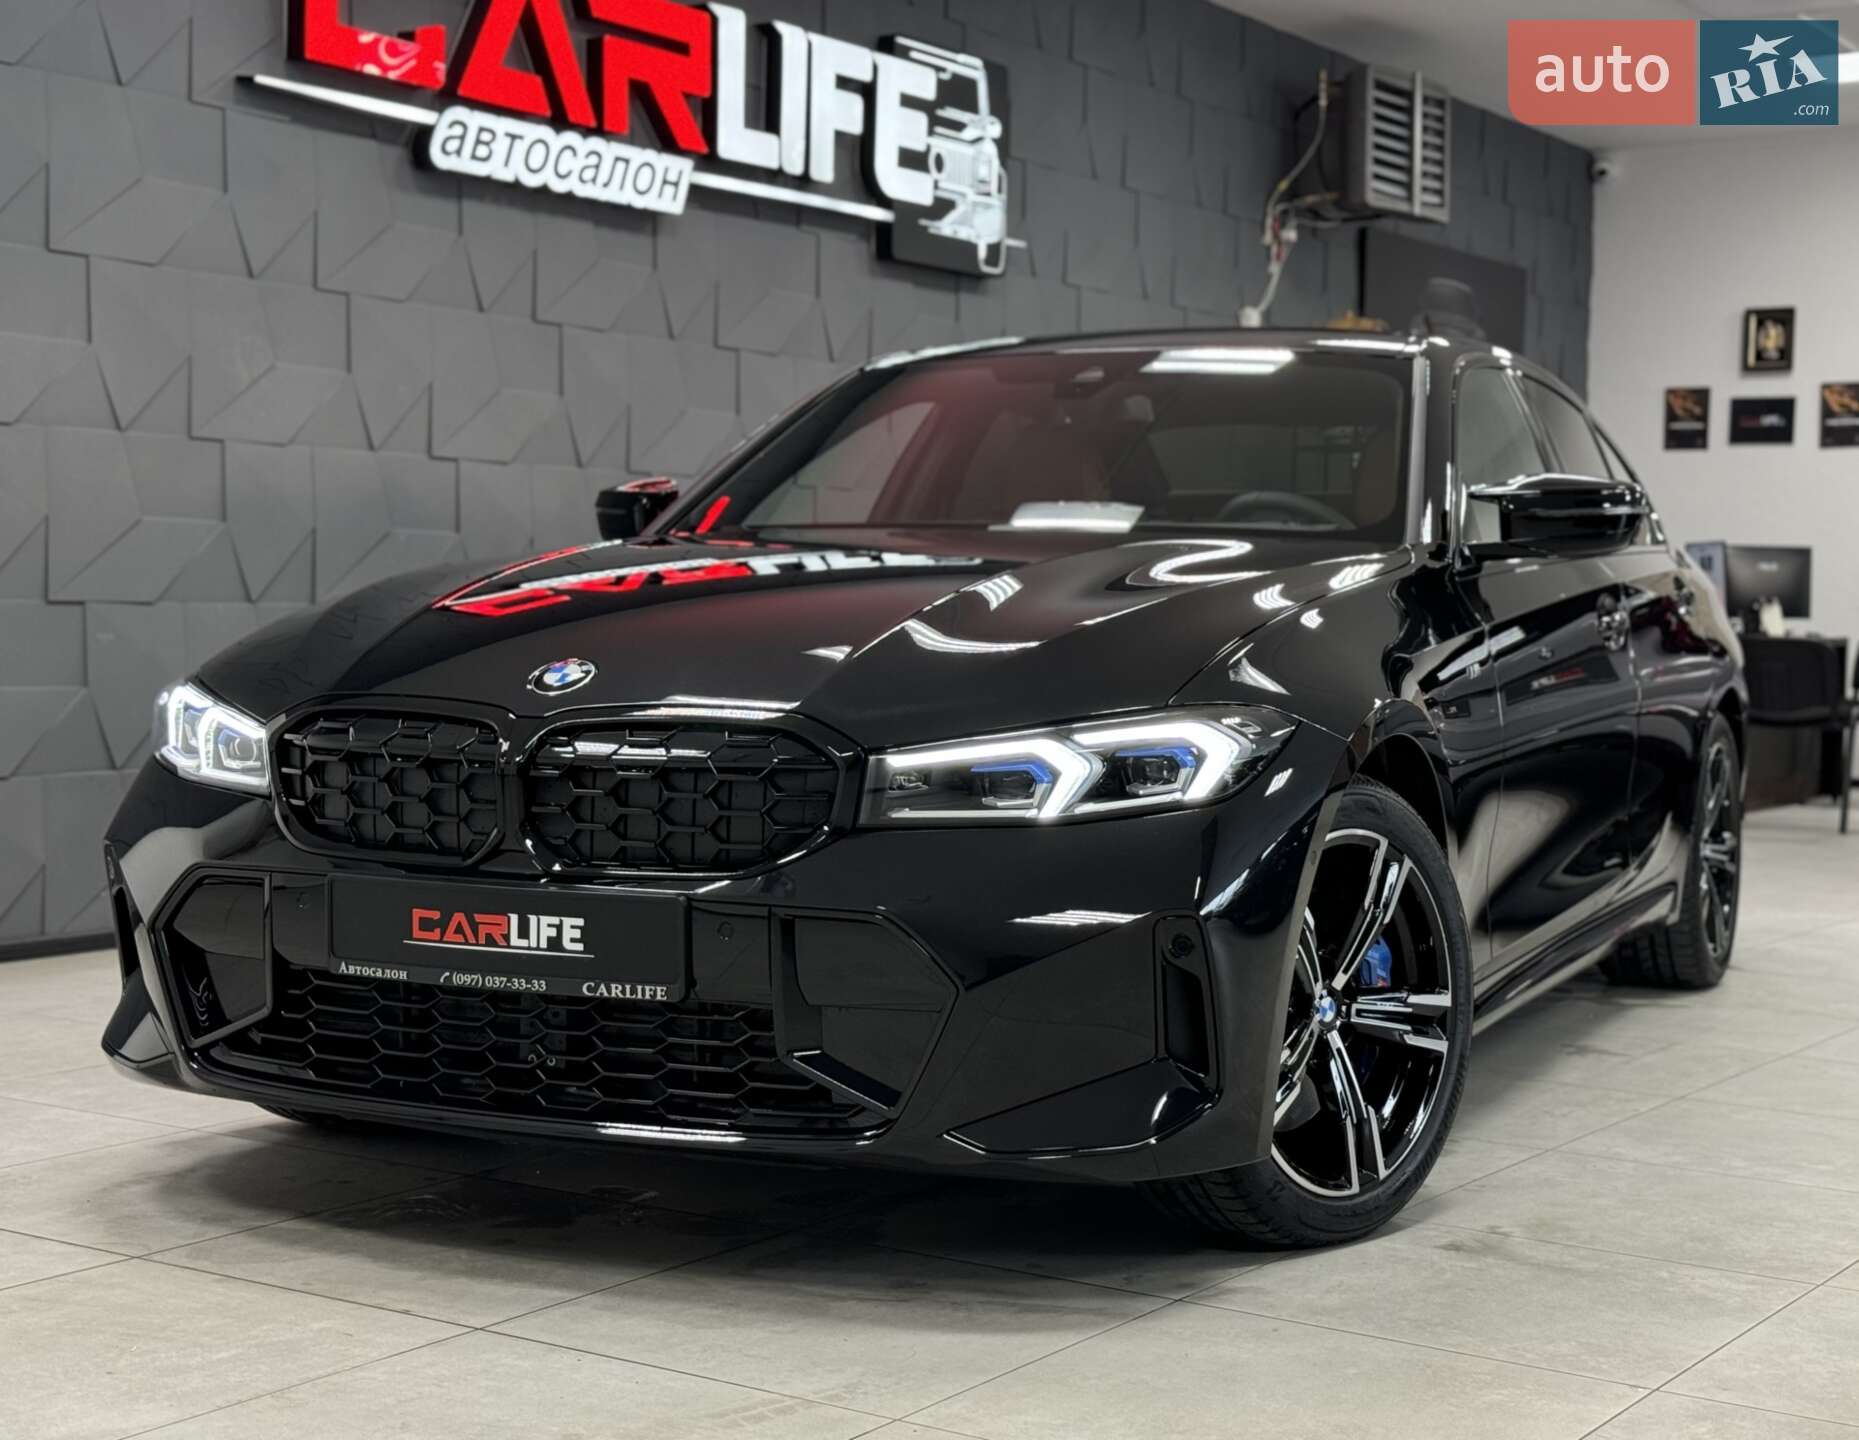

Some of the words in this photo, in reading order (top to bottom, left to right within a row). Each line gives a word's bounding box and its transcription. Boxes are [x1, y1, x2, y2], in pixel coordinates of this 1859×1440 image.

[440, 118, 685, 203] автосалон
[412, 907, 585, 952] CARLIFE
[338, 961, 408, 980] Автосалон
[452, 971, 483, 989] (097)
[485, 975, 546, 992] 037-33-33
[582, 981, 667, 1001] CARLIFE
